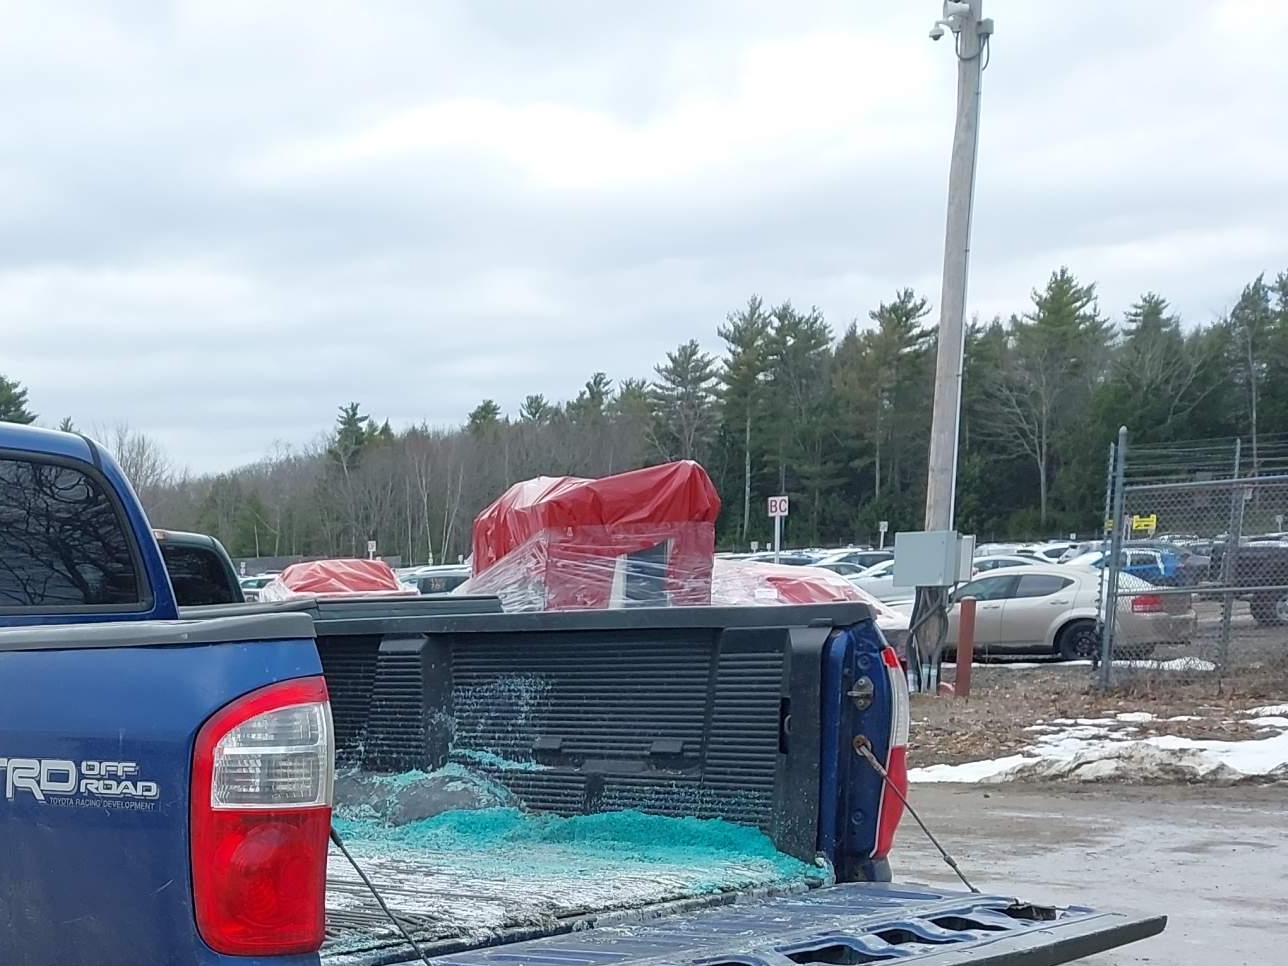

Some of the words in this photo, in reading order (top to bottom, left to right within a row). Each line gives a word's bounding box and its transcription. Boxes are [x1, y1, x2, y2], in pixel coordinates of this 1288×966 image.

[769, 498, 788, 514] BC
[80, 760, 139, 778] OFF
[79, 778, 160, 799] ROAD
[49, 797, 74, 806] TOYOTA
[75, 799, 101, 808] RACING
[103, 800, 156, 811] DEVELOPMENT
